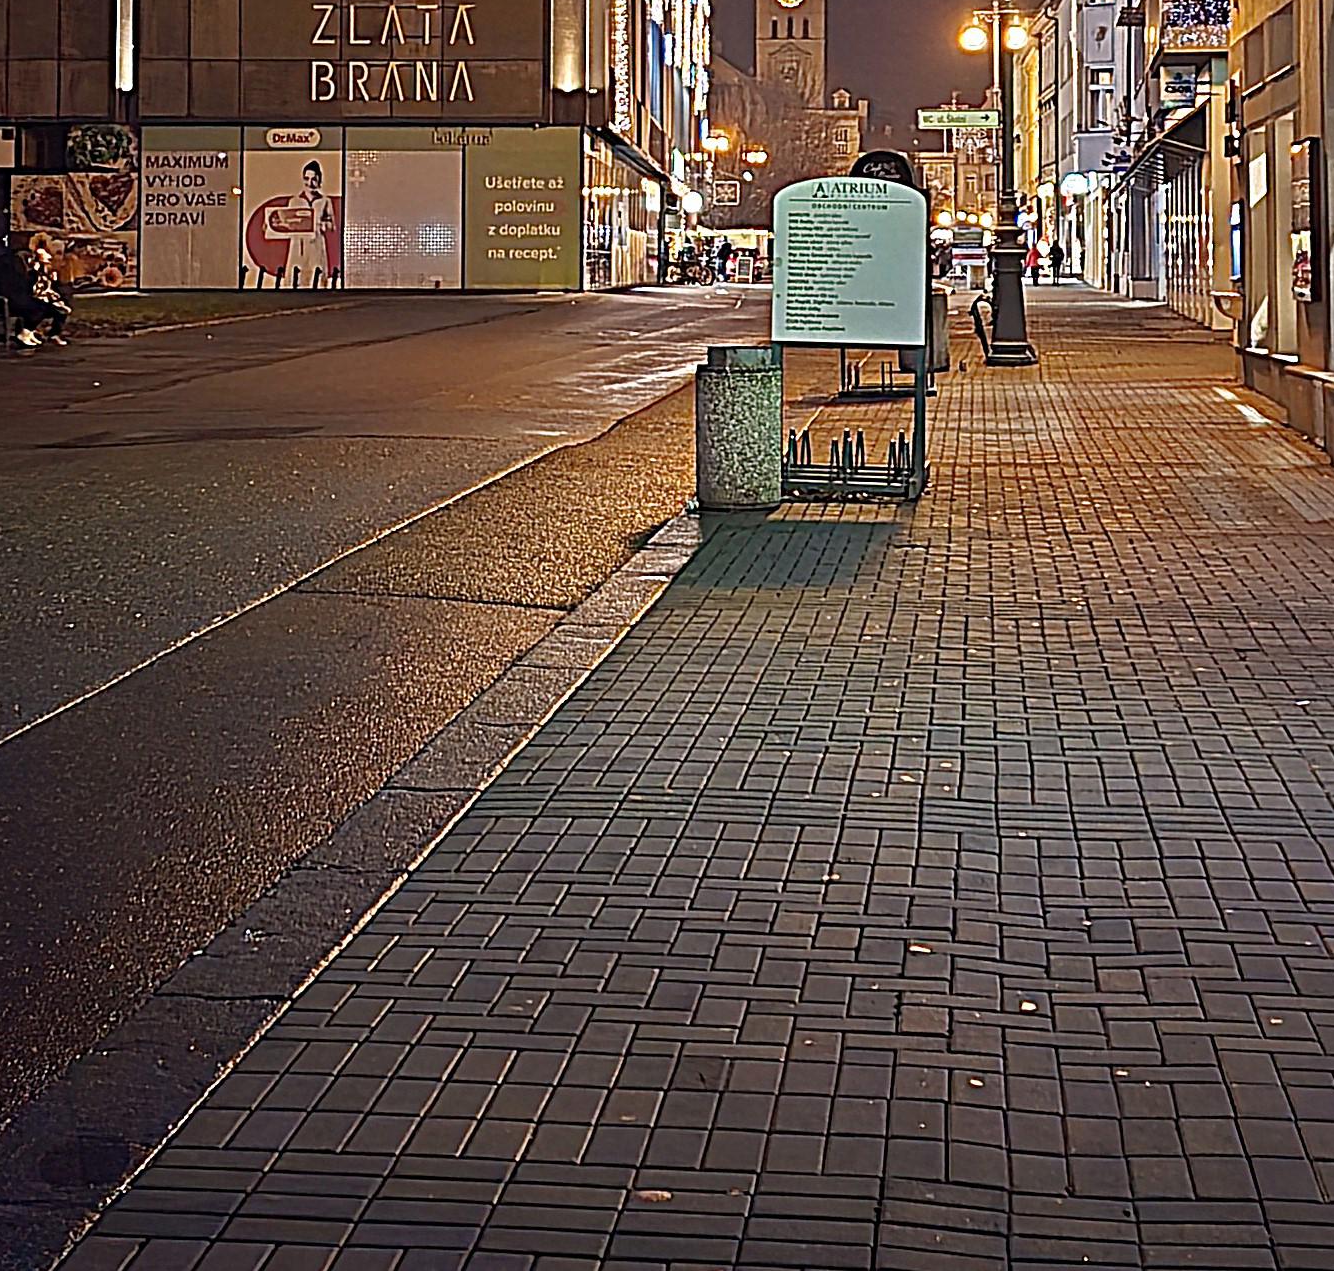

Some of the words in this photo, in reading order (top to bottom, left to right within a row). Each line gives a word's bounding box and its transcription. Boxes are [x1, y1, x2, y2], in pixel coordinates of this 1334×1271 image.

[312, 4, 476, 45] ZLATÁ
[311, 61, 475, 102] BRÁNA
[145, 155, 229, 169] MAXIMUM
[145, 172, 206, 188] VÝHOD
[485, 176, 545, 189] Ušetřete
[548, 177, 564, 189] až
[831, 183, 887, 194] ATRIUM
[145, 193, 179, 207] PRO
[184, 190, 227, 207] VAŠE
[494, 200, 554, 214] polovinu
[488, 226, 496, 236] z
[499, 223, 560, 238] doplatku
[488, 249, 505, 259] na
